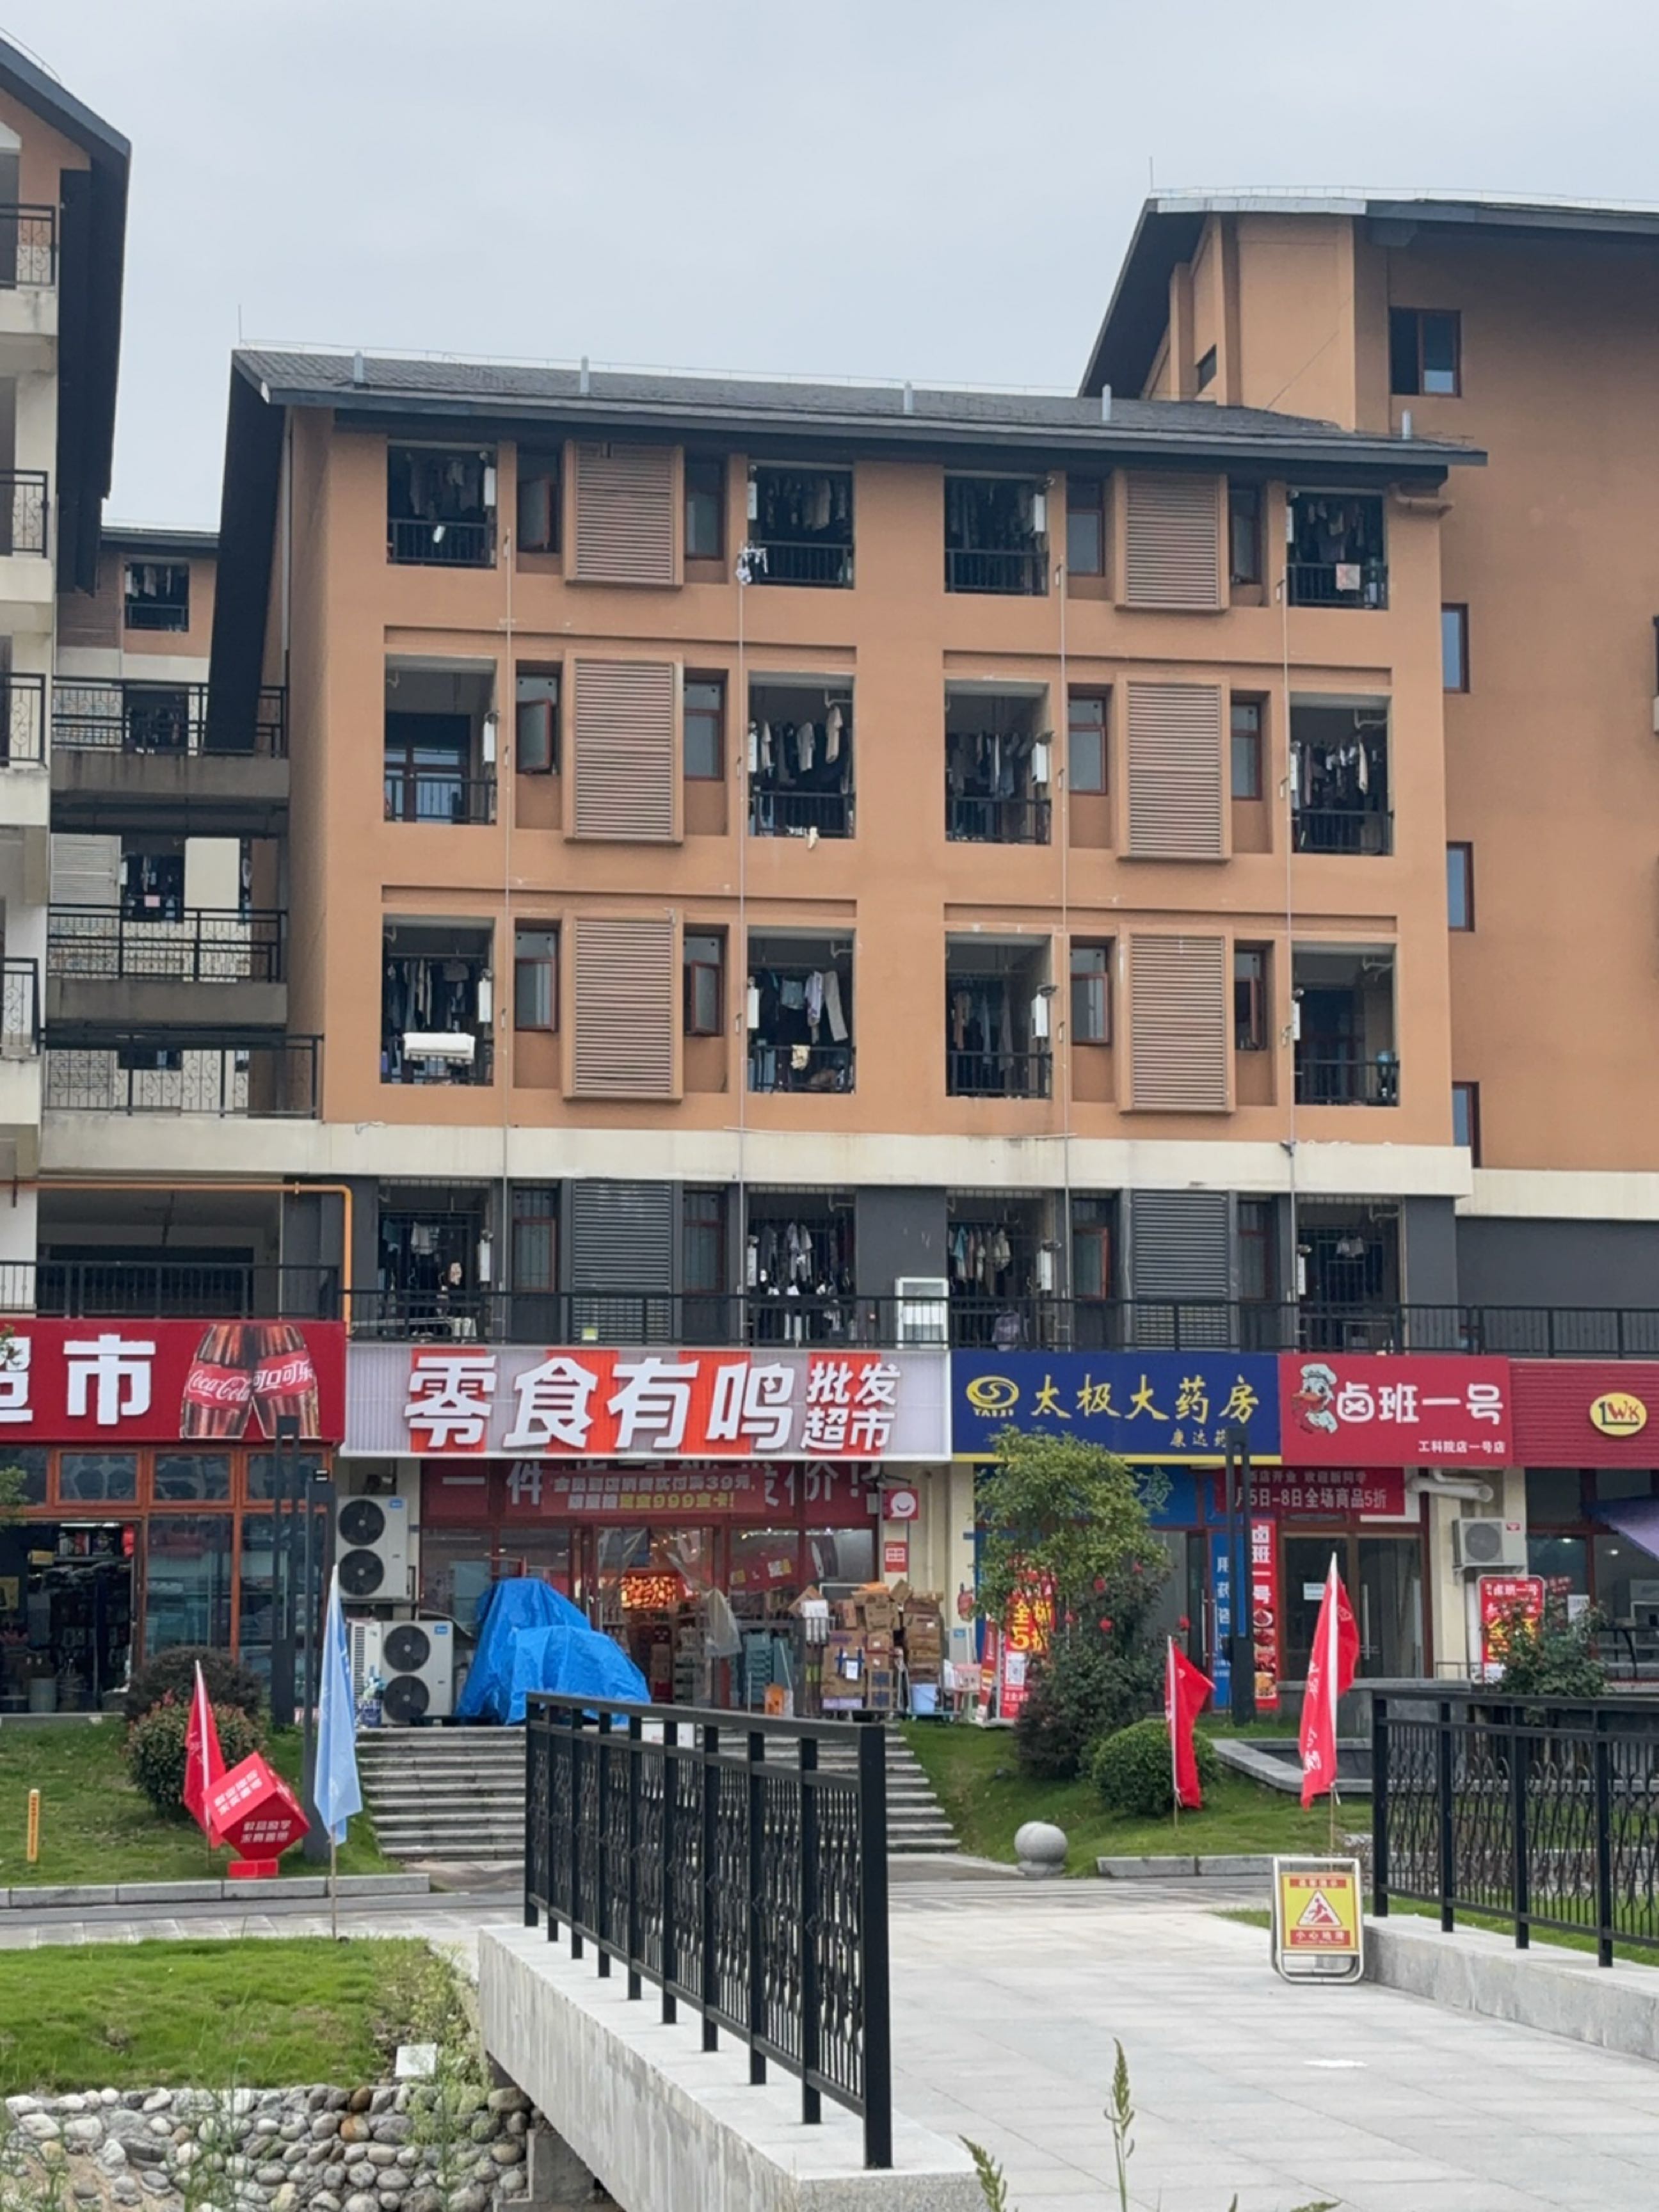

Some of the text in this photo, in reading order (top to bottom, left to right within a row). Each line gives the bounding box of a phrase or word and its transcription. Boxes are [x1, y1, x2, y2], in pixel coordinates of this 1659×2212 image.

[253, 1360, 312, 1390] 可口可乐
[807, 1361, 901, 1406] 批发
[404, 1355, 796, 1450] 零食有鸣
[974, 1408, 1014, 1417] TAIJI
[1031, 1374, 1258, 1424] 太极大药房
[1337, 1382, 1504, 1425] 卤班一号
[801, 1407, 895, 1451] 超市
[1169, 1428, 1227, 1448] 康达药
[1417, 1439, 1505, 1454] 工科院店一号店
[1251, 1524, 1271, 1605] 卤班一号
